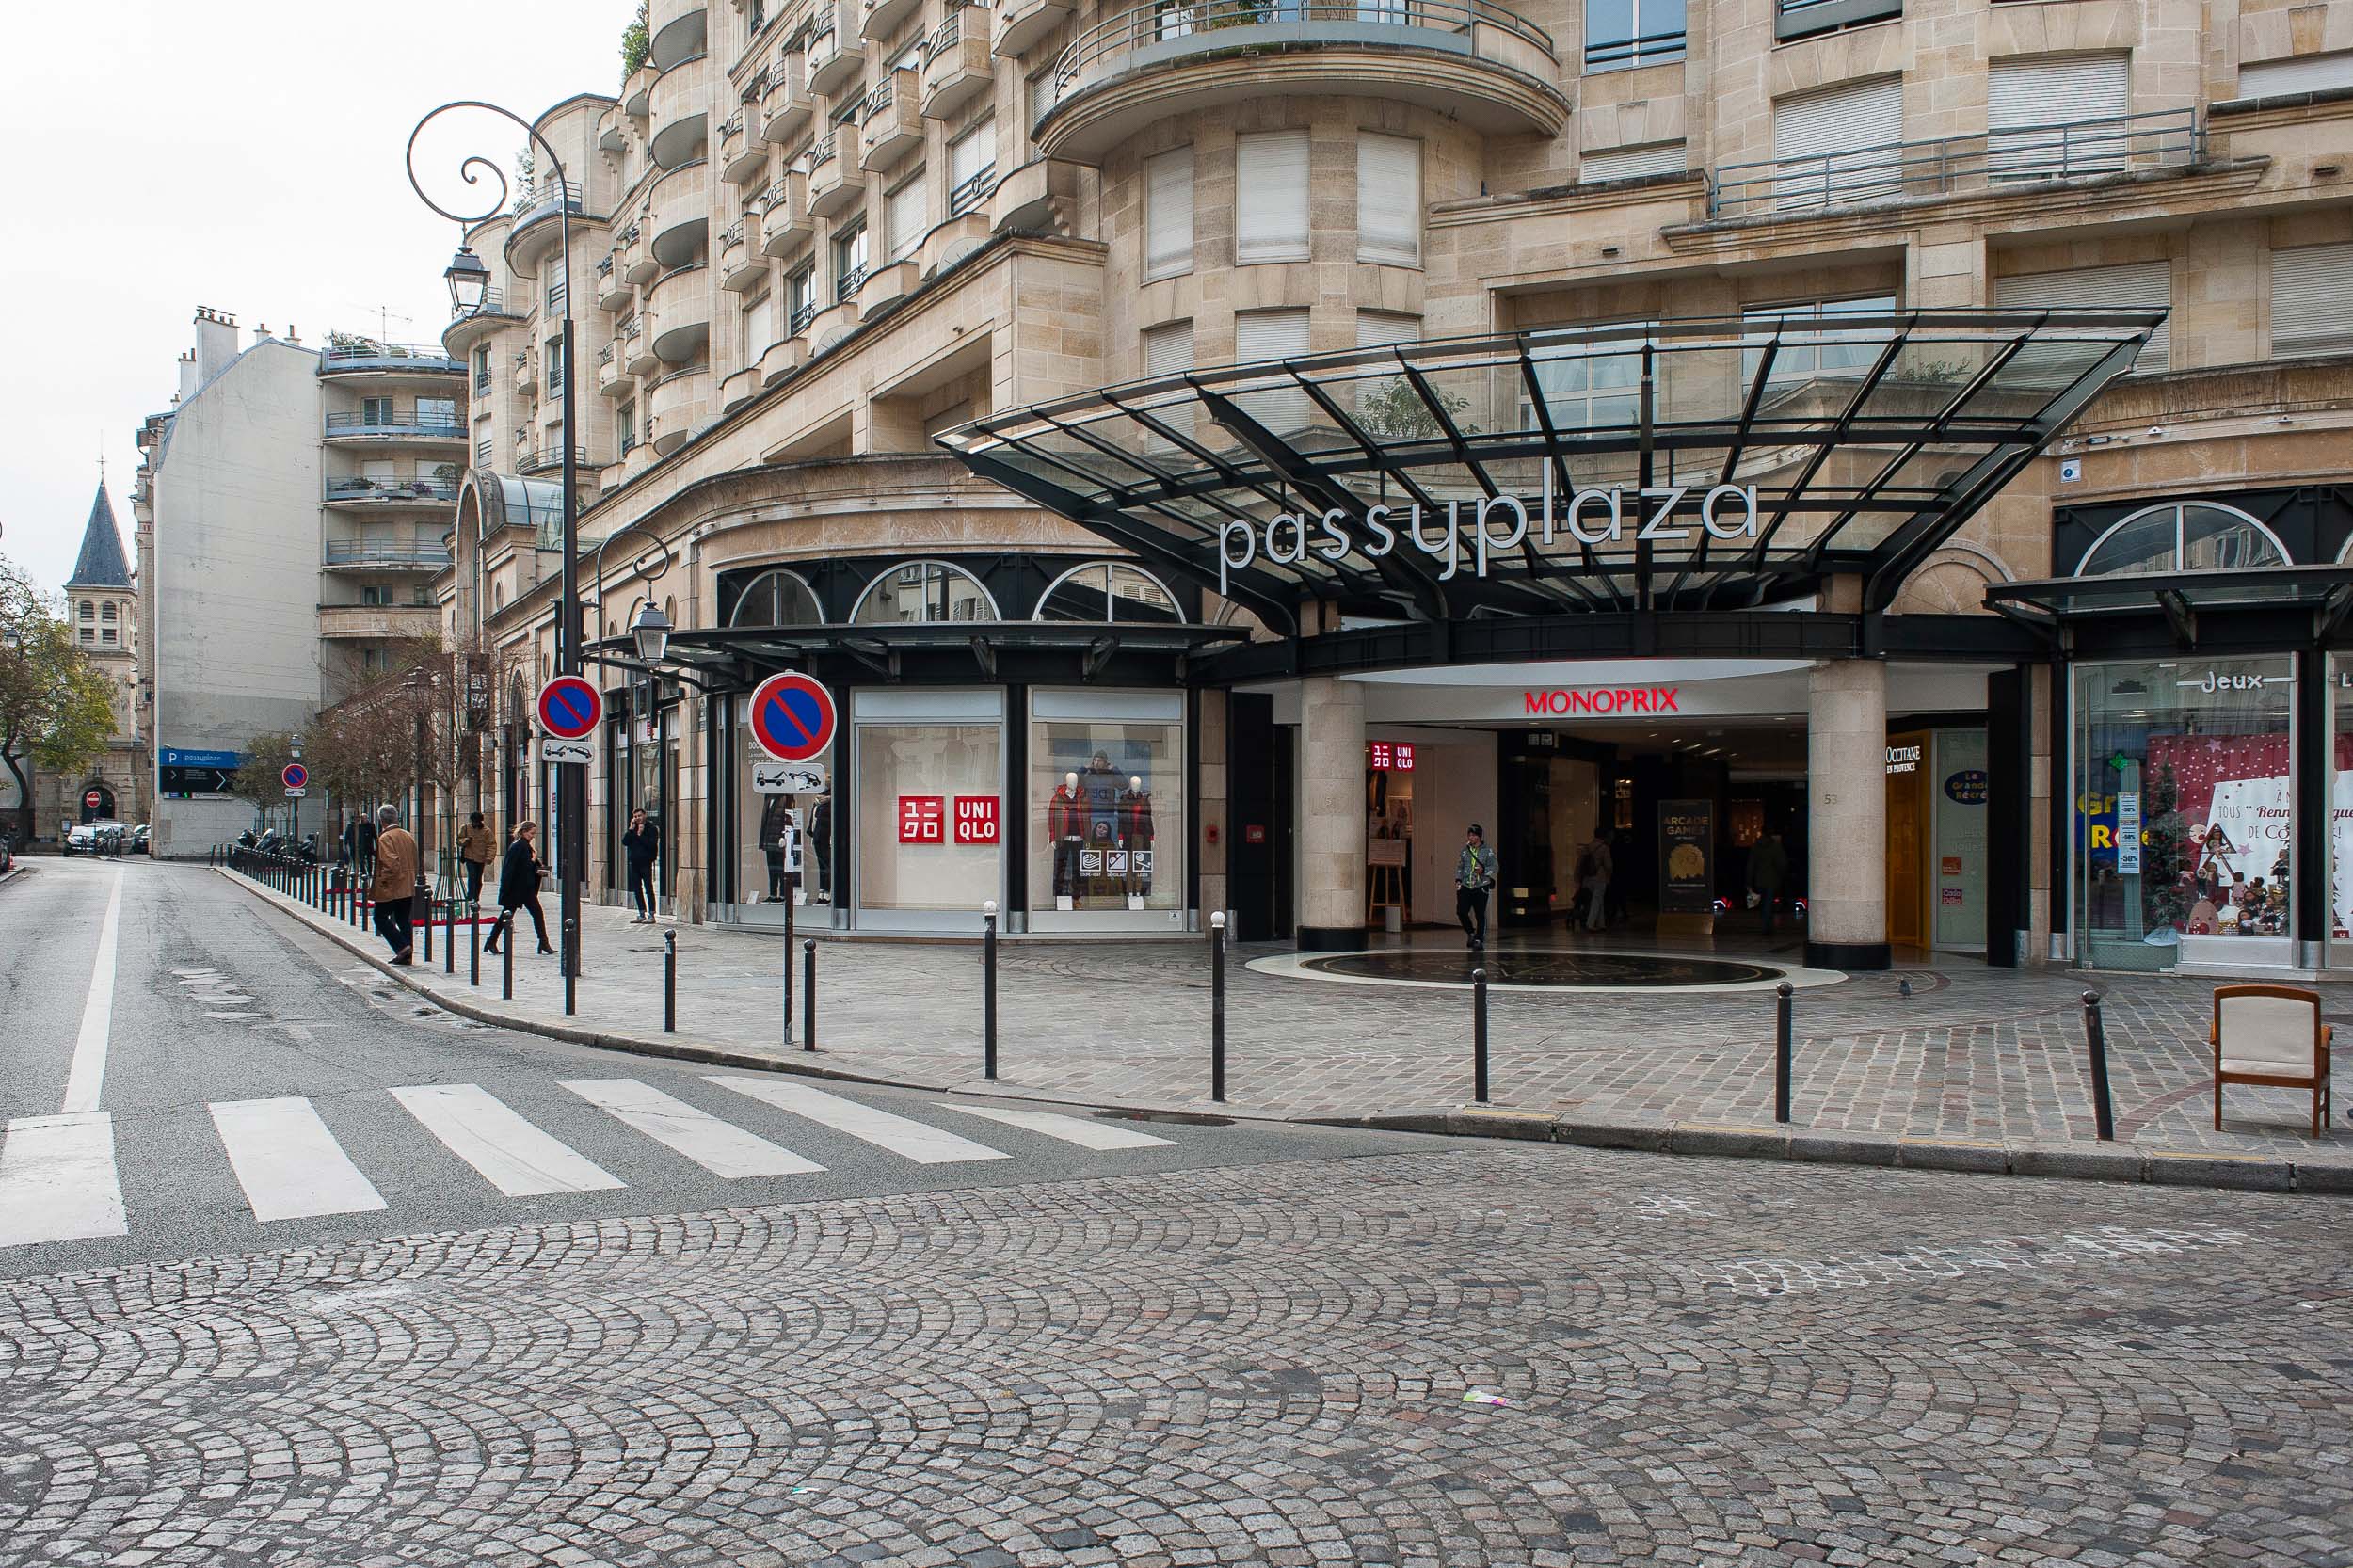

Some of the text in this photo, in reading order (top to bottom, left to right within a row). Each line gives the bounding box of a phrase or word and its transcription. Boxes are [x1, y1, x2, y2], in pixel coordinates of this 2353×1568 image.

[1219, 454, 1759, 597] passyplaza
[2201, 670, 2263, 694] Jeux
[2342, 672, 2353, 687] L
[1524, 687, 1679, 715] MONOPRIX
[959, 801, 991, 819] UNI
[2218, 805, 2242, 819] TOUS
[1664, 816, 1710, 826] ARCADE
[959, 821, 995, 841] QLO
[2249, 825, 2260, 839] DE
